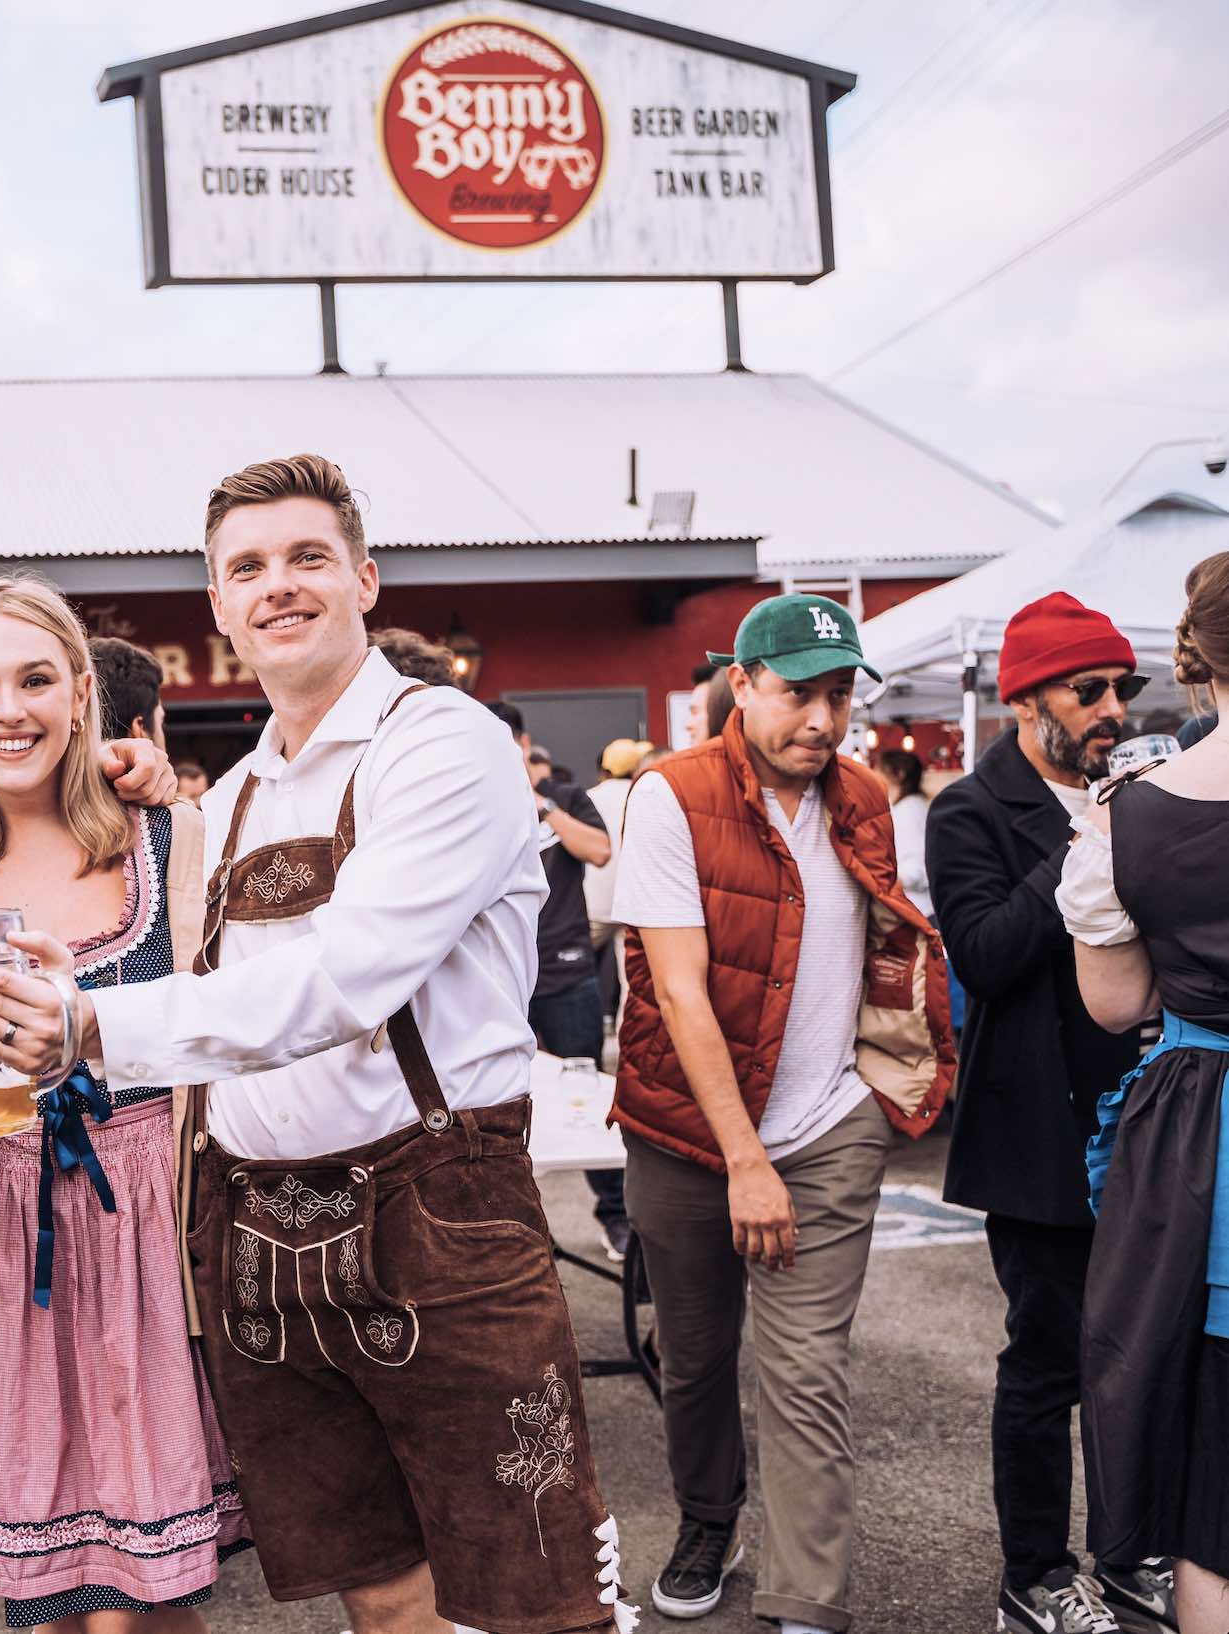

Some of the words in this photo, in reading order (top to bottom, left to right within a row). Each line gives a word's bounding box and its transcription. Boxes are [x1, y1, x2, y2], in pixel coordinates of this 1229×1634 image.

[223, 104, 331, 133] BREWERY
[397, 68, 587, 143] Benny
[631, 107, 683, 136] BEER
[694, 107, 779, 137] GARDEN
[412, 120, 525, 186] Boy
[202, 167, 269, 195] CIDER
[280, 167, 355, 197] HOUSE
[654, 169, 710, 197] TANK
[721, 170, 765, 197] BAR
[449, 182, 552, 224] Brewing
[808, 606, 842, 640] LA
